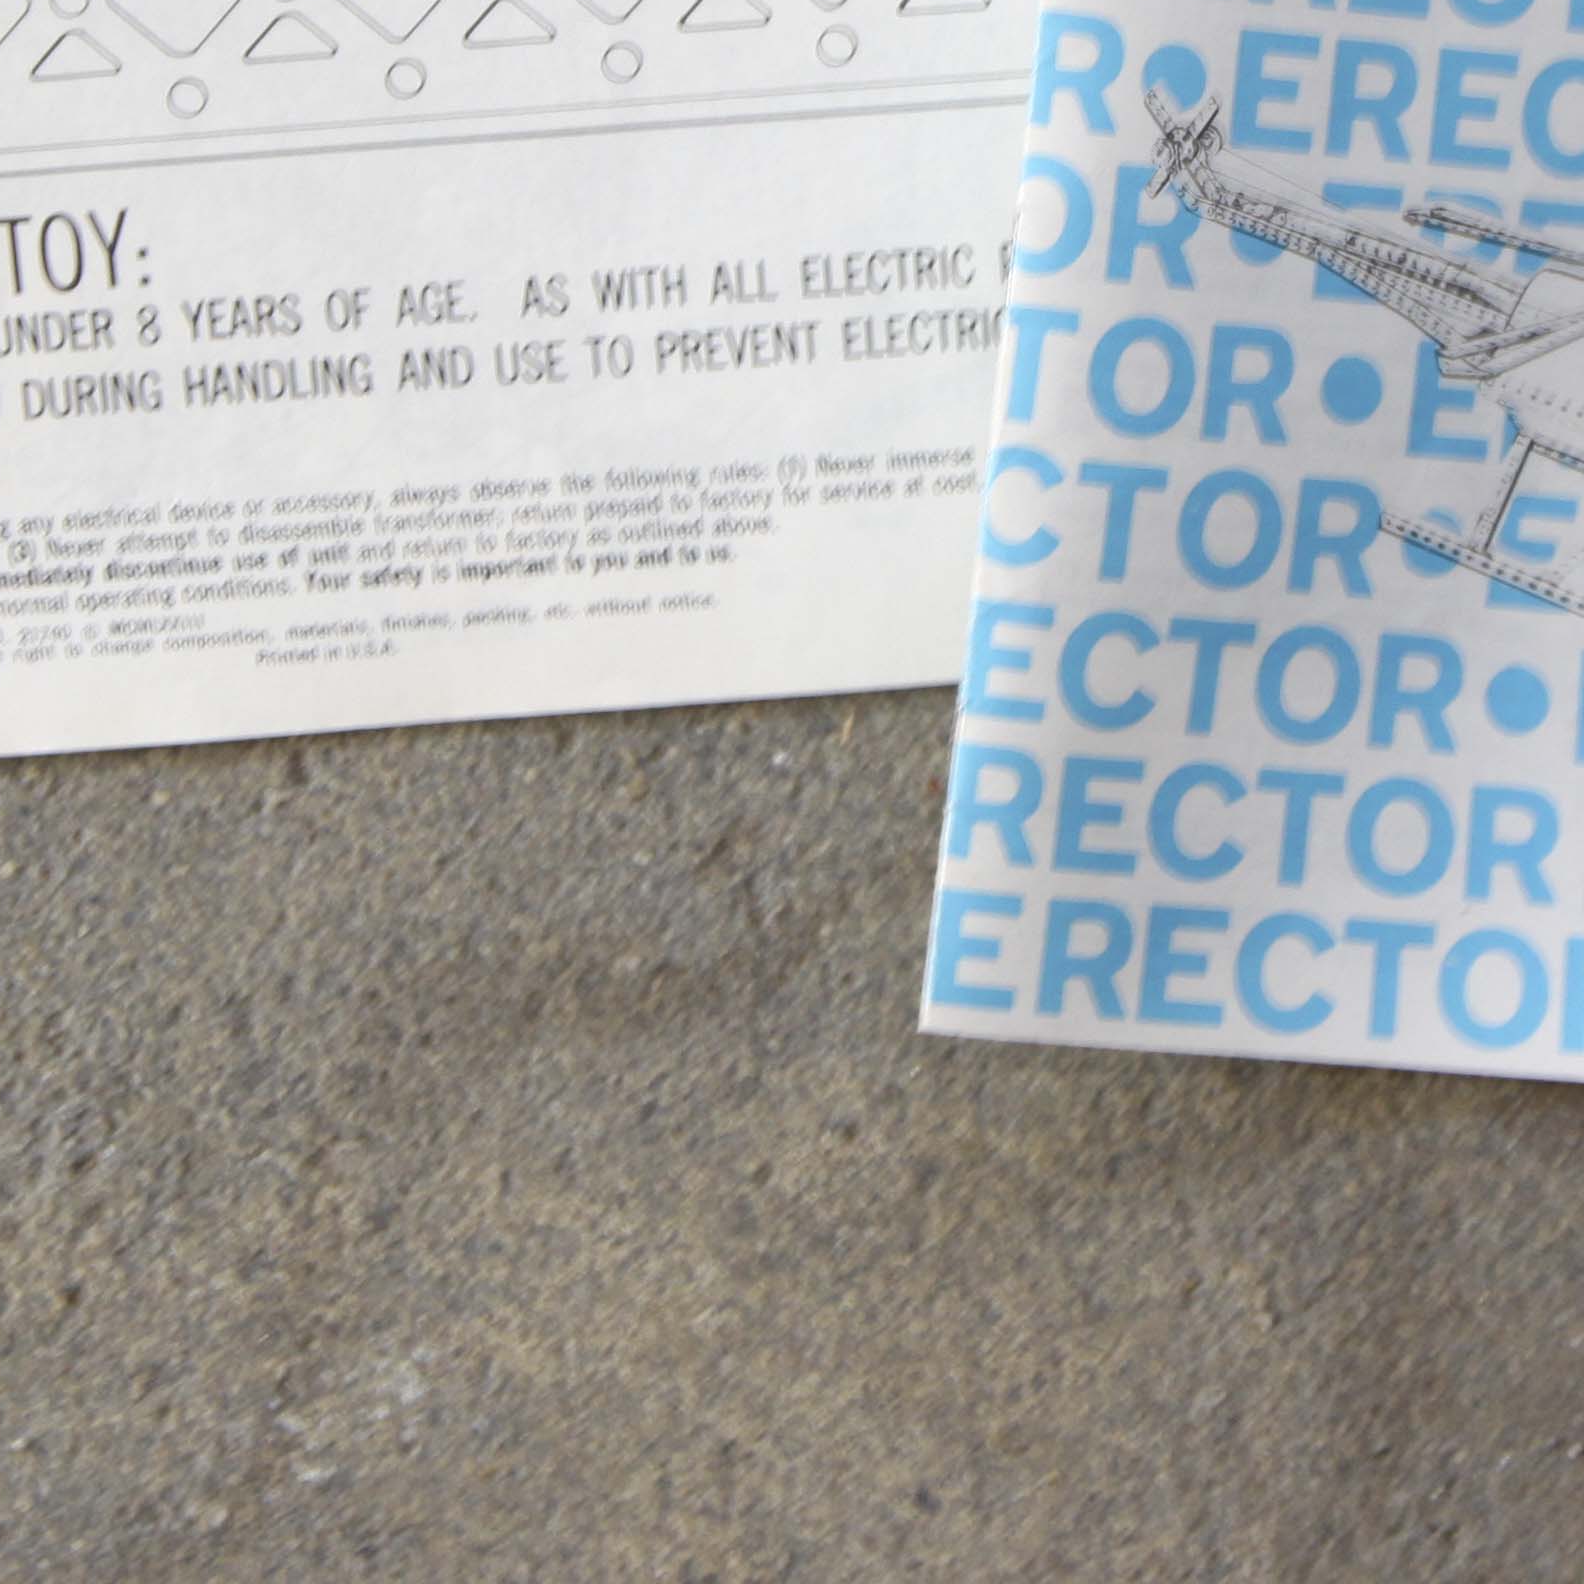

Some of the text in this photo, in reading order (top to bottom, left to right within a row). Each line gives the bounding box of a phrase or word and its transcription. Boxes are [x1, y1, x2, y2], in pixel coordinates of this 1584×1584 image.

[136, 304, 162, 347] 8
[180, 293, 304, 342] YEARS
[324, 287, 371, 333] OF
[395, 279, 478, 328] AGE.
[521, 273, 570, 318] AS
[591, 264, 688, 314] WITH
[710, 258, 778, 305] ALL
[799, 243, 976, 299] ELECTRIC
[21, 369, 164, 422] DURING
[182, 352, 374, 408] HANDLING
[397, 345, 475, 392] AND
[493, 340, 569, 386] USE
[582, 335, 634, 378] TO
[654, 320, 820, 374] PREVENT
[1003, 304, 1296, 444] TOR
[978, 445, 1383, 598] CTOR
[960, 598, 1466, 754] ECTOR
[945, 742, 1562, 906] RECTOR
